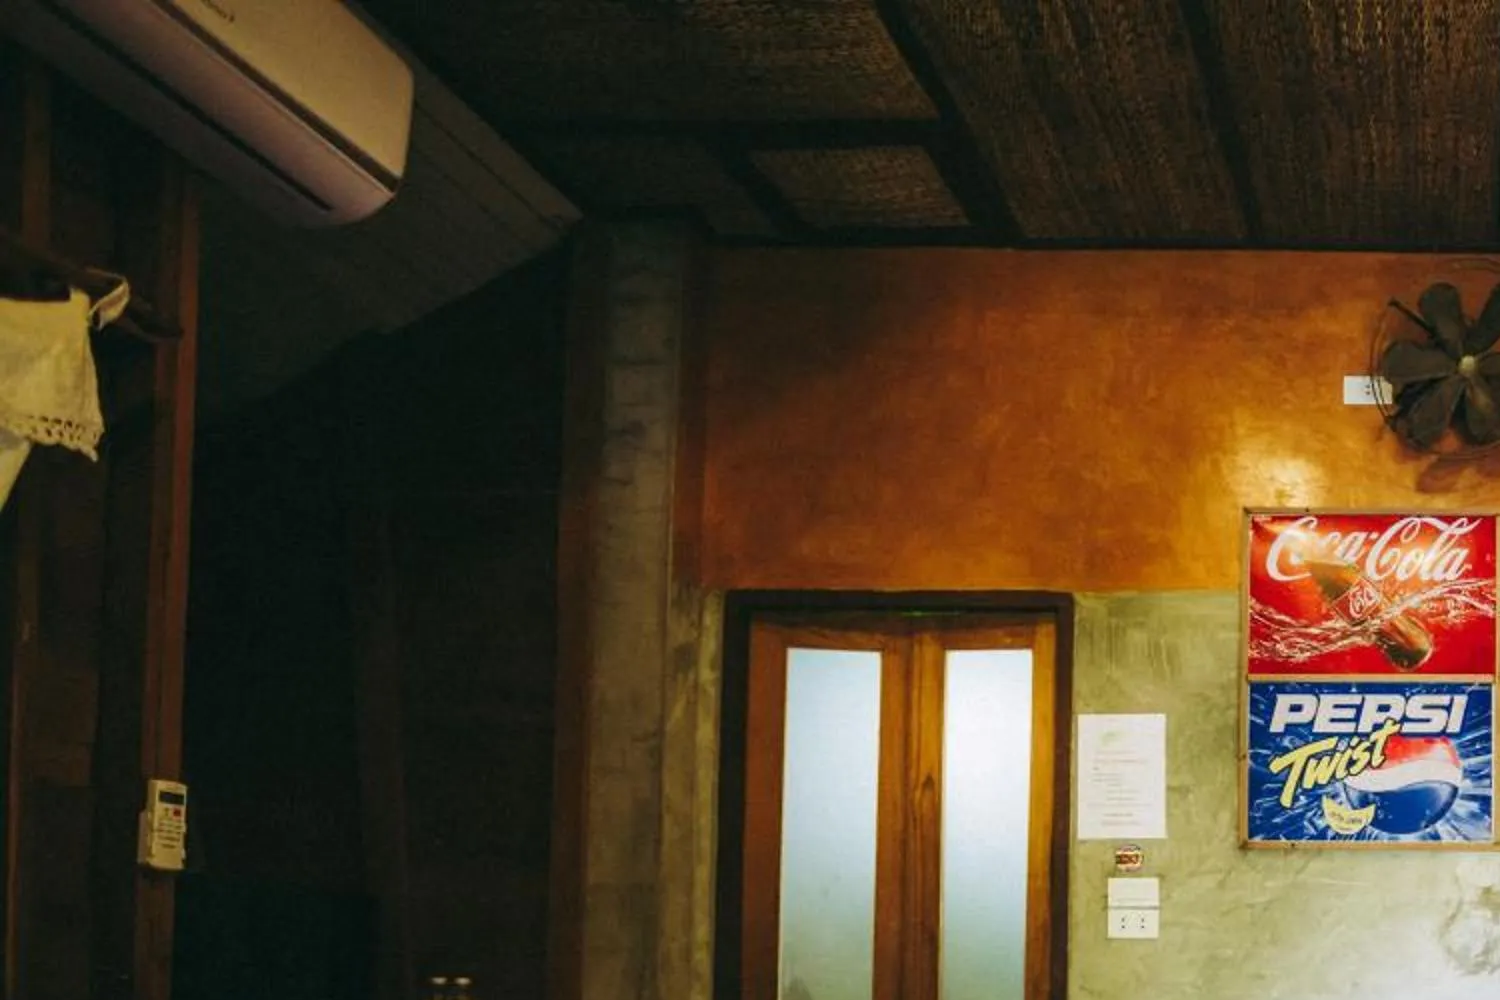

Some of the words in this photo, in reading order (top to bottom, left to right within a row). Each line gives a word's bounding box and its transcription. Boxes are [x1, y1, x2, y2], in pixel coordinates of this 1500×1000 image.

[1266, 517, 1482, 582] Coca-Cola
[1269, 693, 1468, 733] PEPSI
[1269, 718, 1401, 808] Twist
